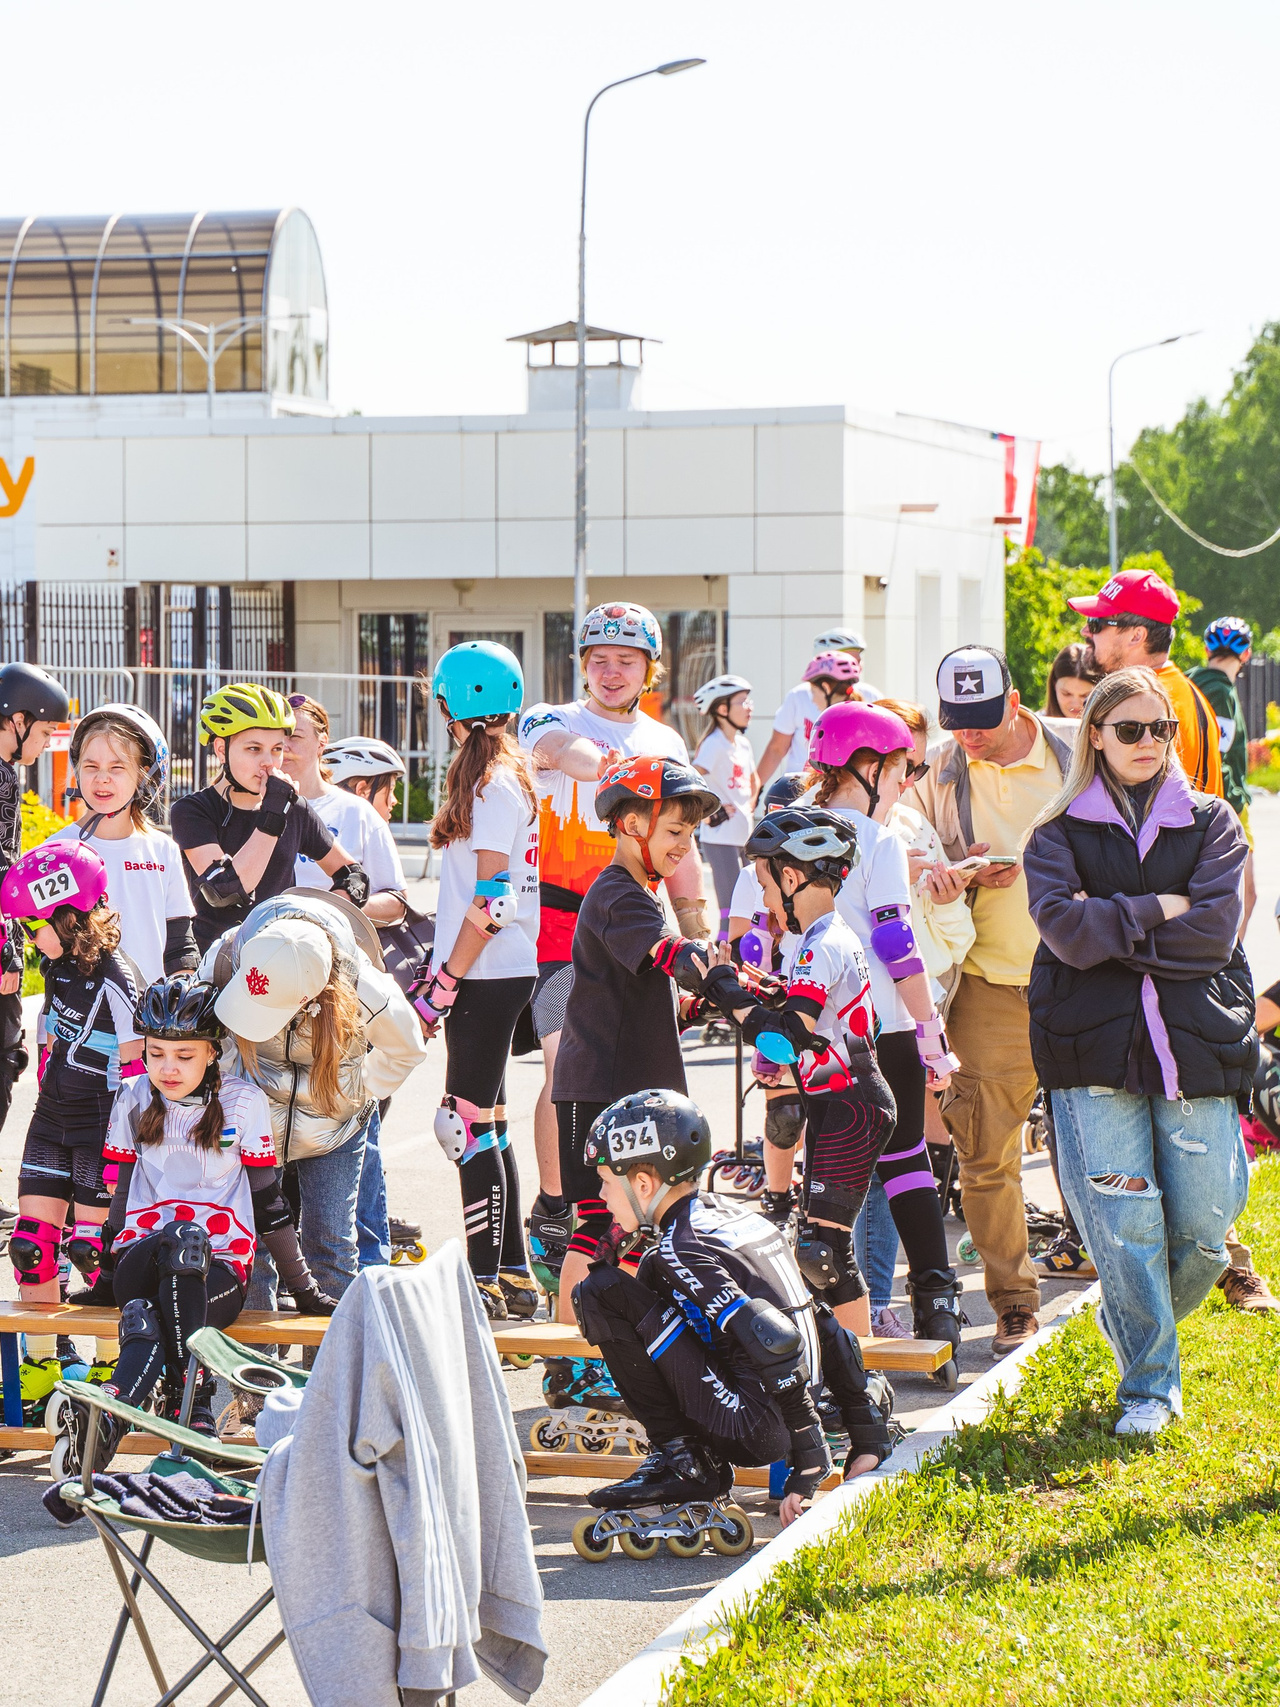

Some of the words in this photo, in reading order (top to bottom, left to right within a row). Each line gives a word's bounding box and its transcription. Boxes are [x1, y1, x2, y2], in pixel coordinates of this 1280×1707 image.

[33, 872, 70, 901] 129
[611, 1126, 654, 1152] 394
[491, 1185, 501, 1246] WHATEVER
